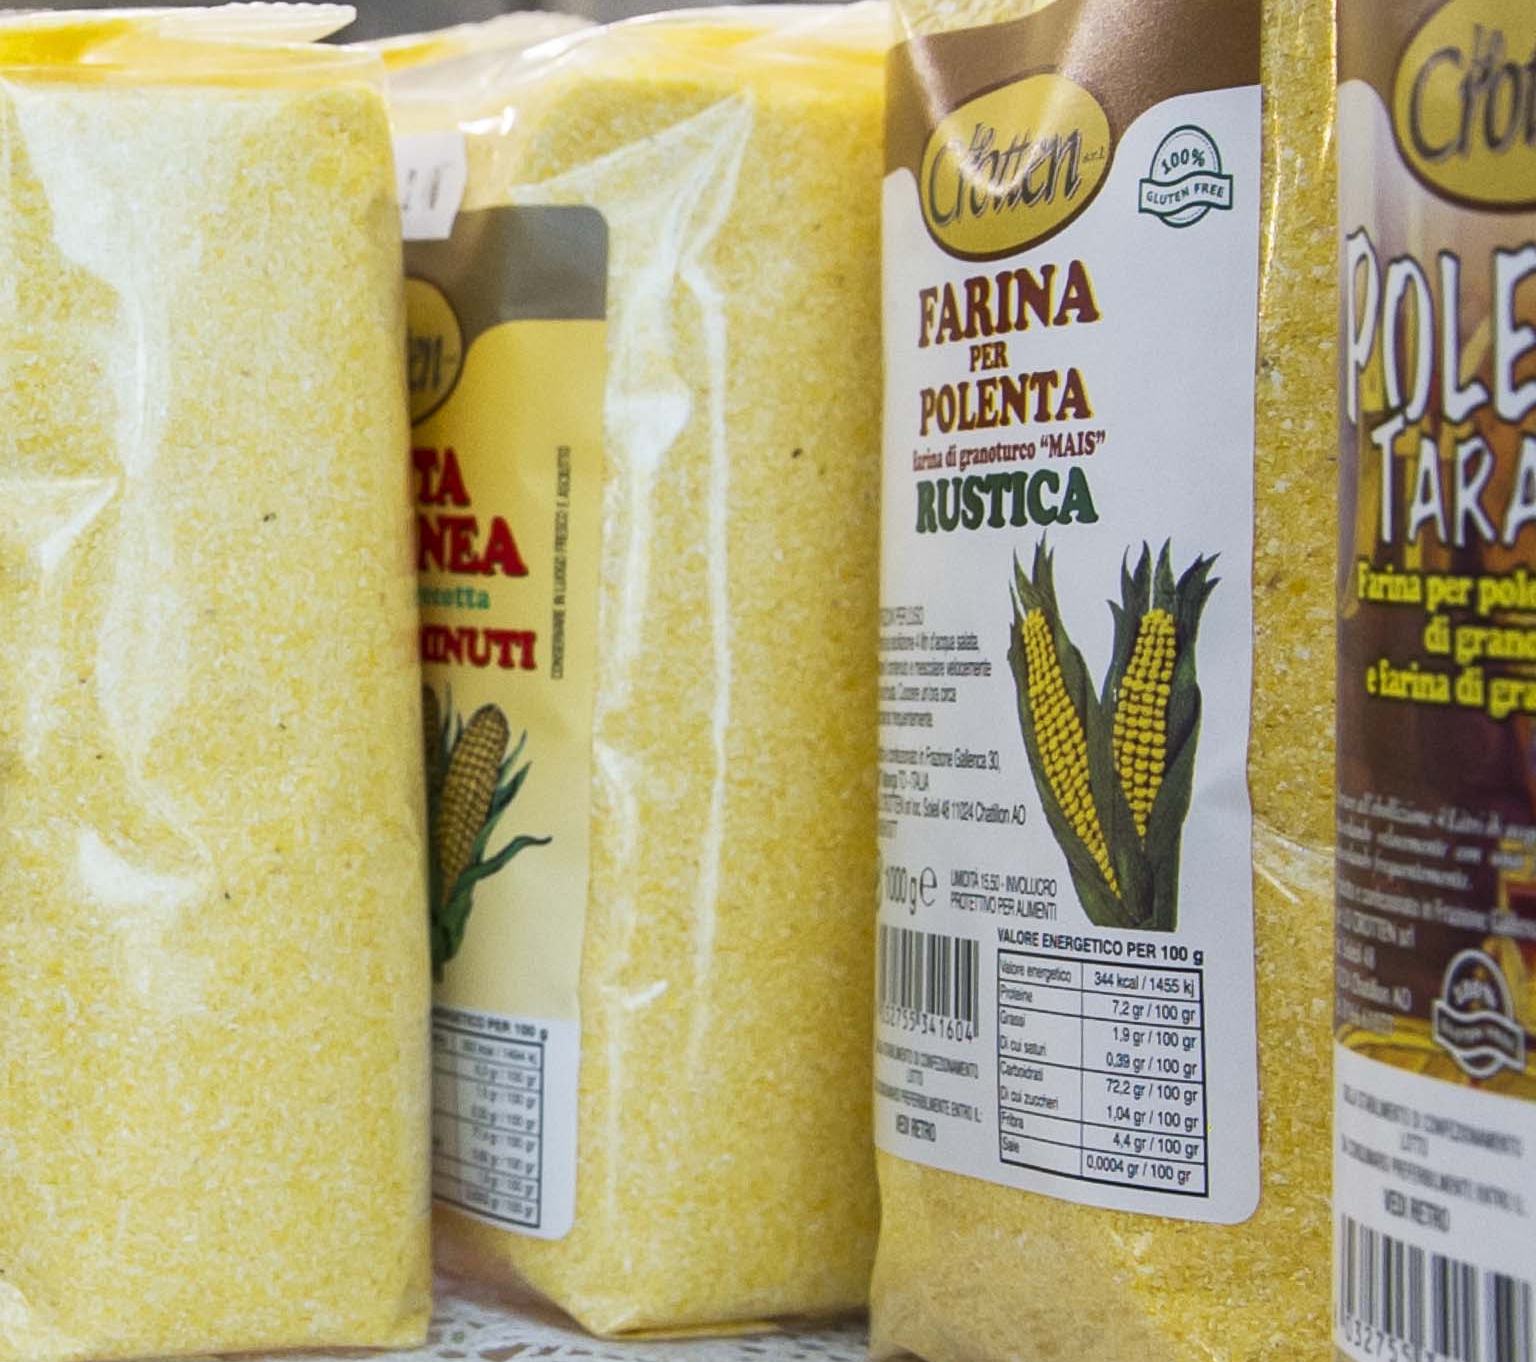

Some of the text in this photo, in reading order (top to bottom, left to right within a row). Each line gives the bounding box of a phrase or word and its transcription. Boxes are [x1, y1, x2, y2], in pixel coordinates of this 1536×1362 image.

[1161, 147, 1206, 175] 100%
[1145, 180, 1225, 206] GLUTEN FREE
[917, 259, 1104, 348] FARINA
[968, 340, 1009, 373] PER
[918, 367, 1094, 437] POLENTA
[913, 448, 943, 471] farina
[945, 444, 957, 469] di
[959, 441, 1036, 473] granoturco
[916, 465, 1100, 534] RUSTICA
[1356, 559, 1423, 604] Farina
[1428, 573, 1474, 613] per
[1423, 614, 1451, 655] di
[1365, 667, 1377, 695] e
[1379, 658, 1451, 702] farina
[1455, 665, 1485, 707] di
[1011, 803, 1027, 827] AO
[909, 875, 918, 917] g
[1006, 874, 1058, 898] INVOLUCRO
[997, 927, 1204, 966] VALORE ENERGETICO PER 100 g
[999, 958, 1072, 984] Valore energetico
[1094, 970, 1114, 987] 344
[1116, 972, 1140, 991] kcal
[1149, 976, 1180, 994] 1455
[1183, 978, 1195, 998] kj
[921, 1012, 974, 1044] 341604
[1132, 1004, 1145, 1020] gr
[1154, 1003, 1178, 1021] 100
[1181, 1008, 1196, 1025] gr
[1133, 1031, 1145, 1047] gr
[1156, 1030, 1179, 1048] 100
[1182, 1035, 1197, 1052] gr
[1133, 1057, 1146, 1074] gr
[1156, 1057, 1179, 1075] 100
[1182, 1063, 1197, 1079] gr
[1133, 1084, 1146, 1101] gr
[1156, 1084, 1180, 1101] 100
[1183, 1089, 1198, 1106] gr
[1133, 1110, 1147, 1127] gr
[1157, 1110, 1181, 1128] 100
[1184, 1116, 1200, 1132] gr
[1133, 1137, 1147, 1153] gr
[1157, 1138, 1182, 1155] 100
[1185, 1142, 1200, 1159] gr
[1127, 1163, 1140, 1179] gr
[1150, 1163, 1174, 1181] 100
[1177, 1168, 1192, 1185] gr
